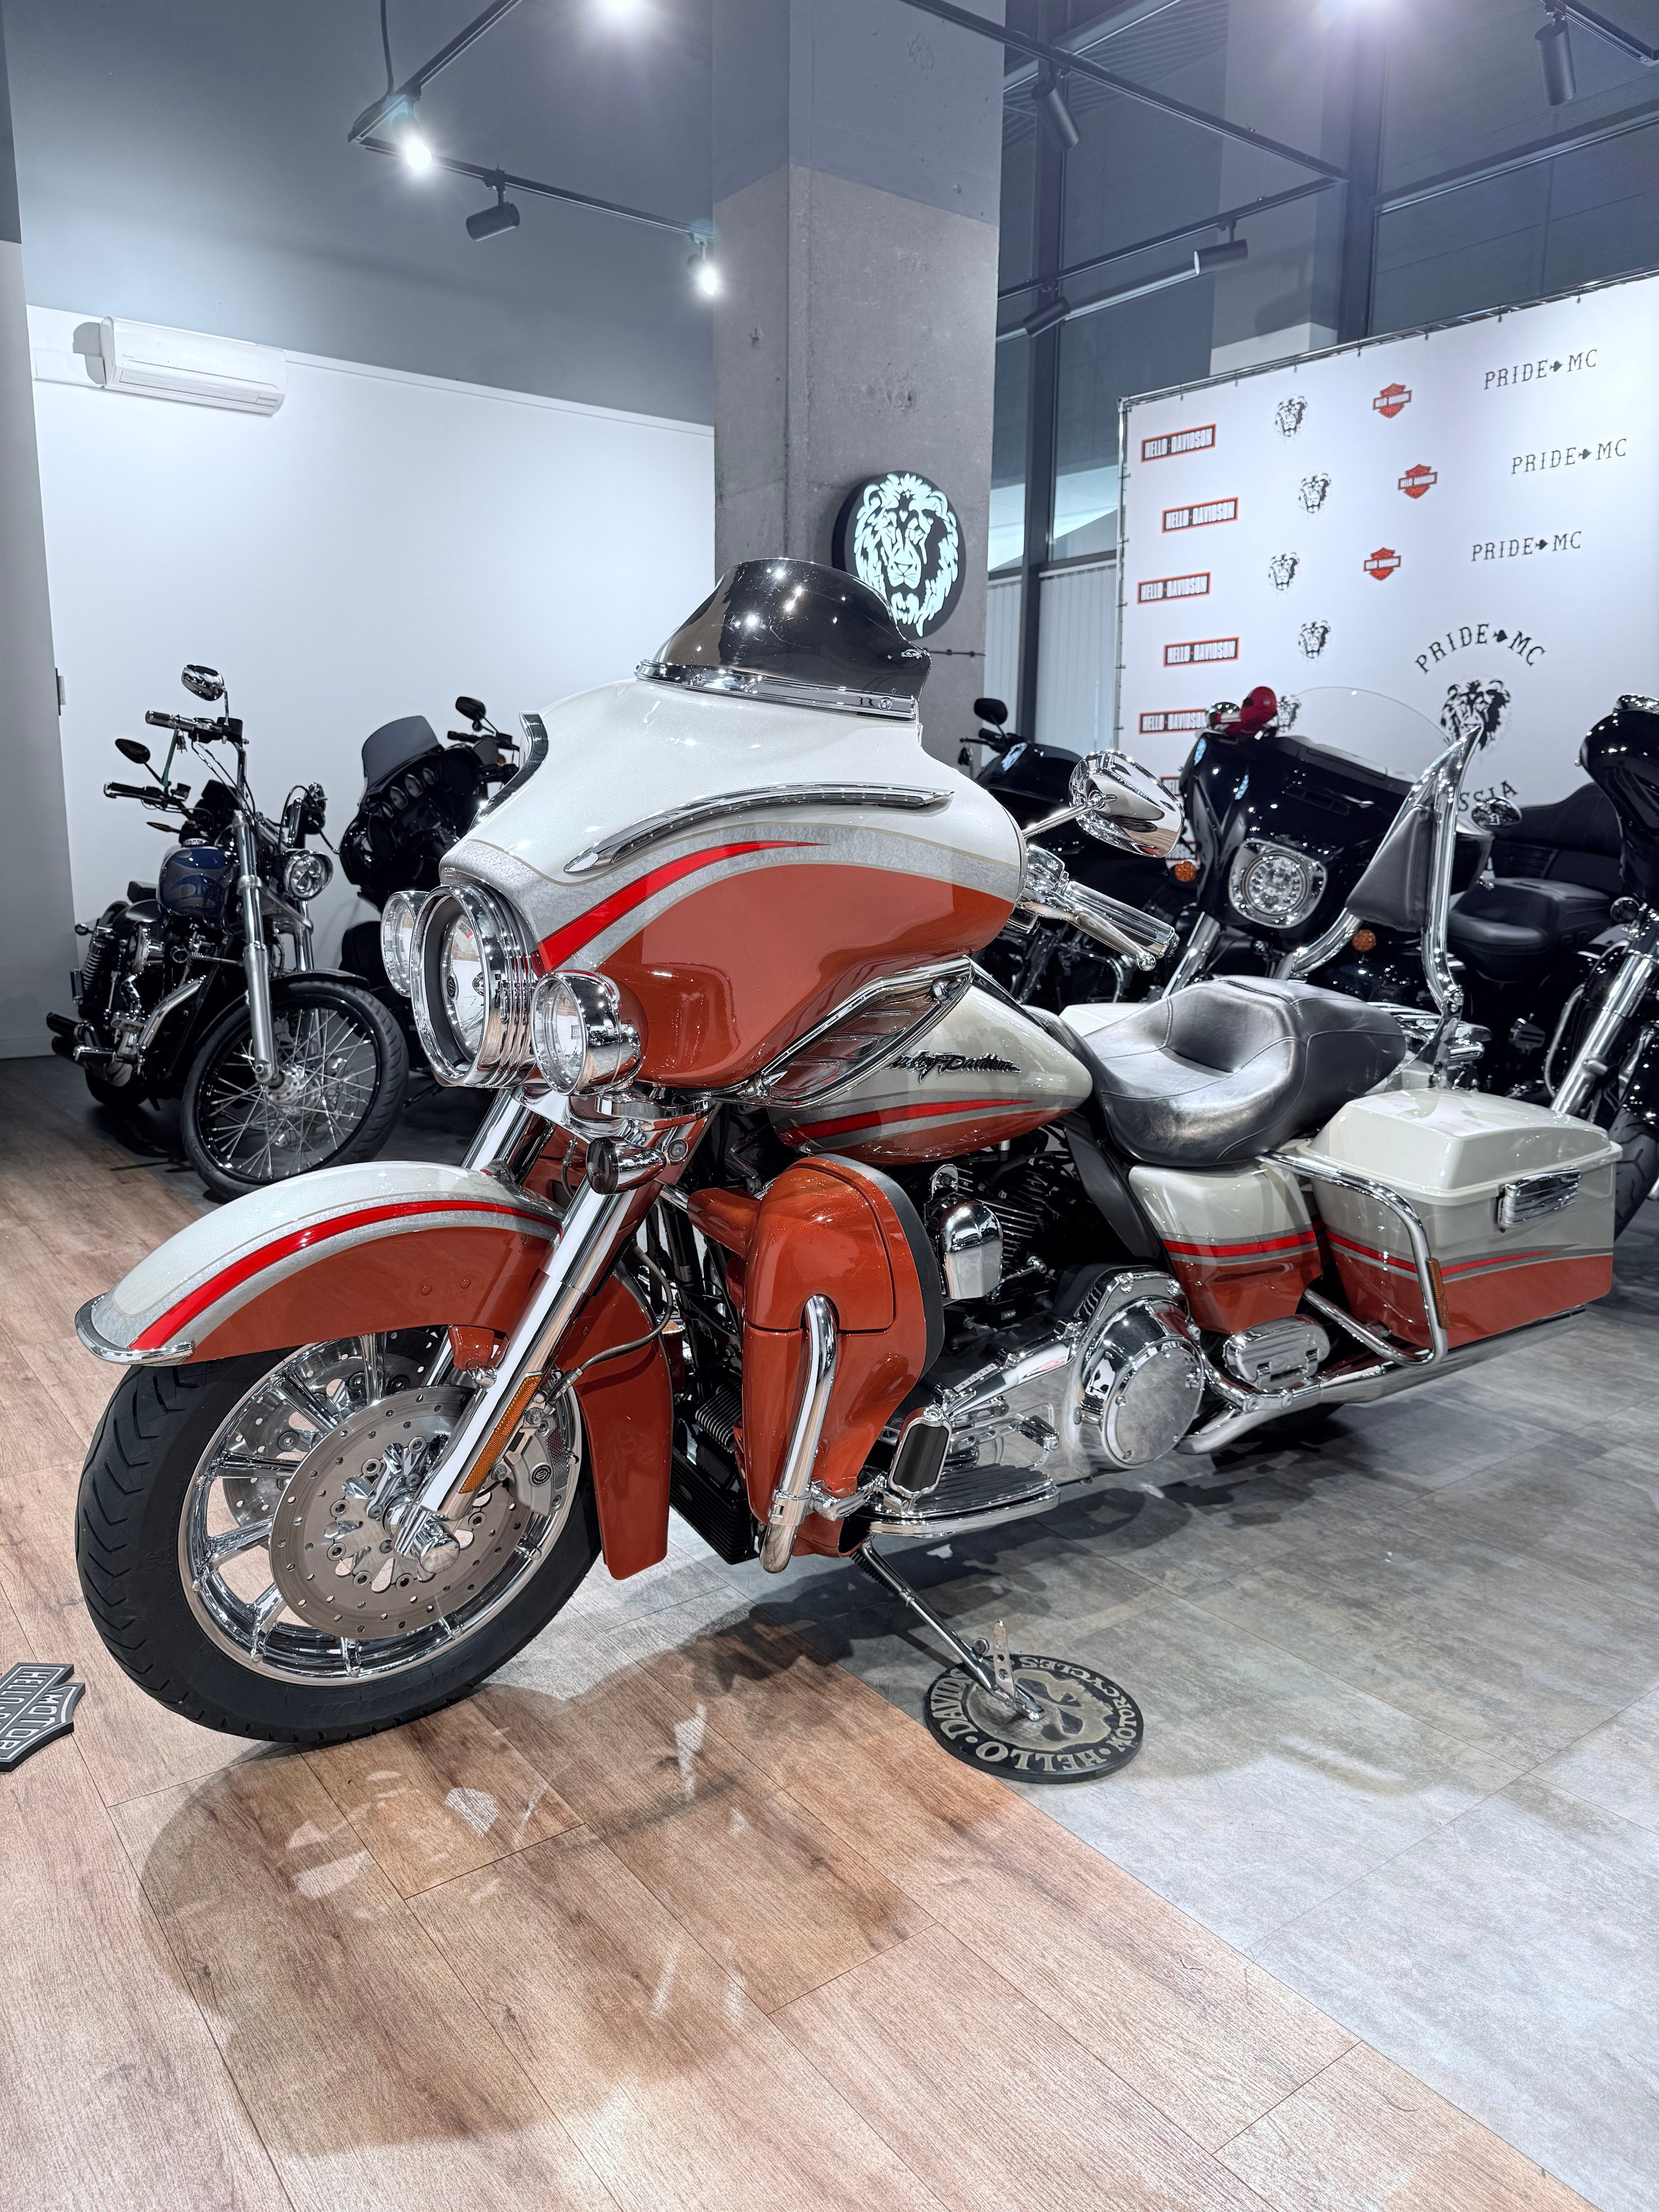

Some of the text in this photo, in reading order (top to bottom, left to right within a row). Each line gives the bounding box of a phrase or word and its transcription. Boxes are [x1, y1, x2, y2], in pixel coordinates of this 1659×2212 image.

[1483, 349, 1597, 390] PRIDE MC
[1144, 427, 1214, 460] HELLO DAVIDSON
[1511, 438, 1627, 474] PRIDE MC
[1165, 500, 1236, 530] HELLO DAVIDSON
[1470, 531, 1582, 562] PRIDE MC
[1140, 574, 1208, 601] HELLO DAVIDSON
[1166, 639, 1236, 664] HELLO DAVIDSON
[1414, 623, 1547, 675] PRIDE MC
[1142, 714, 1165, 732] HELLO
[975, 1741, 1108, 1772] HELLO
